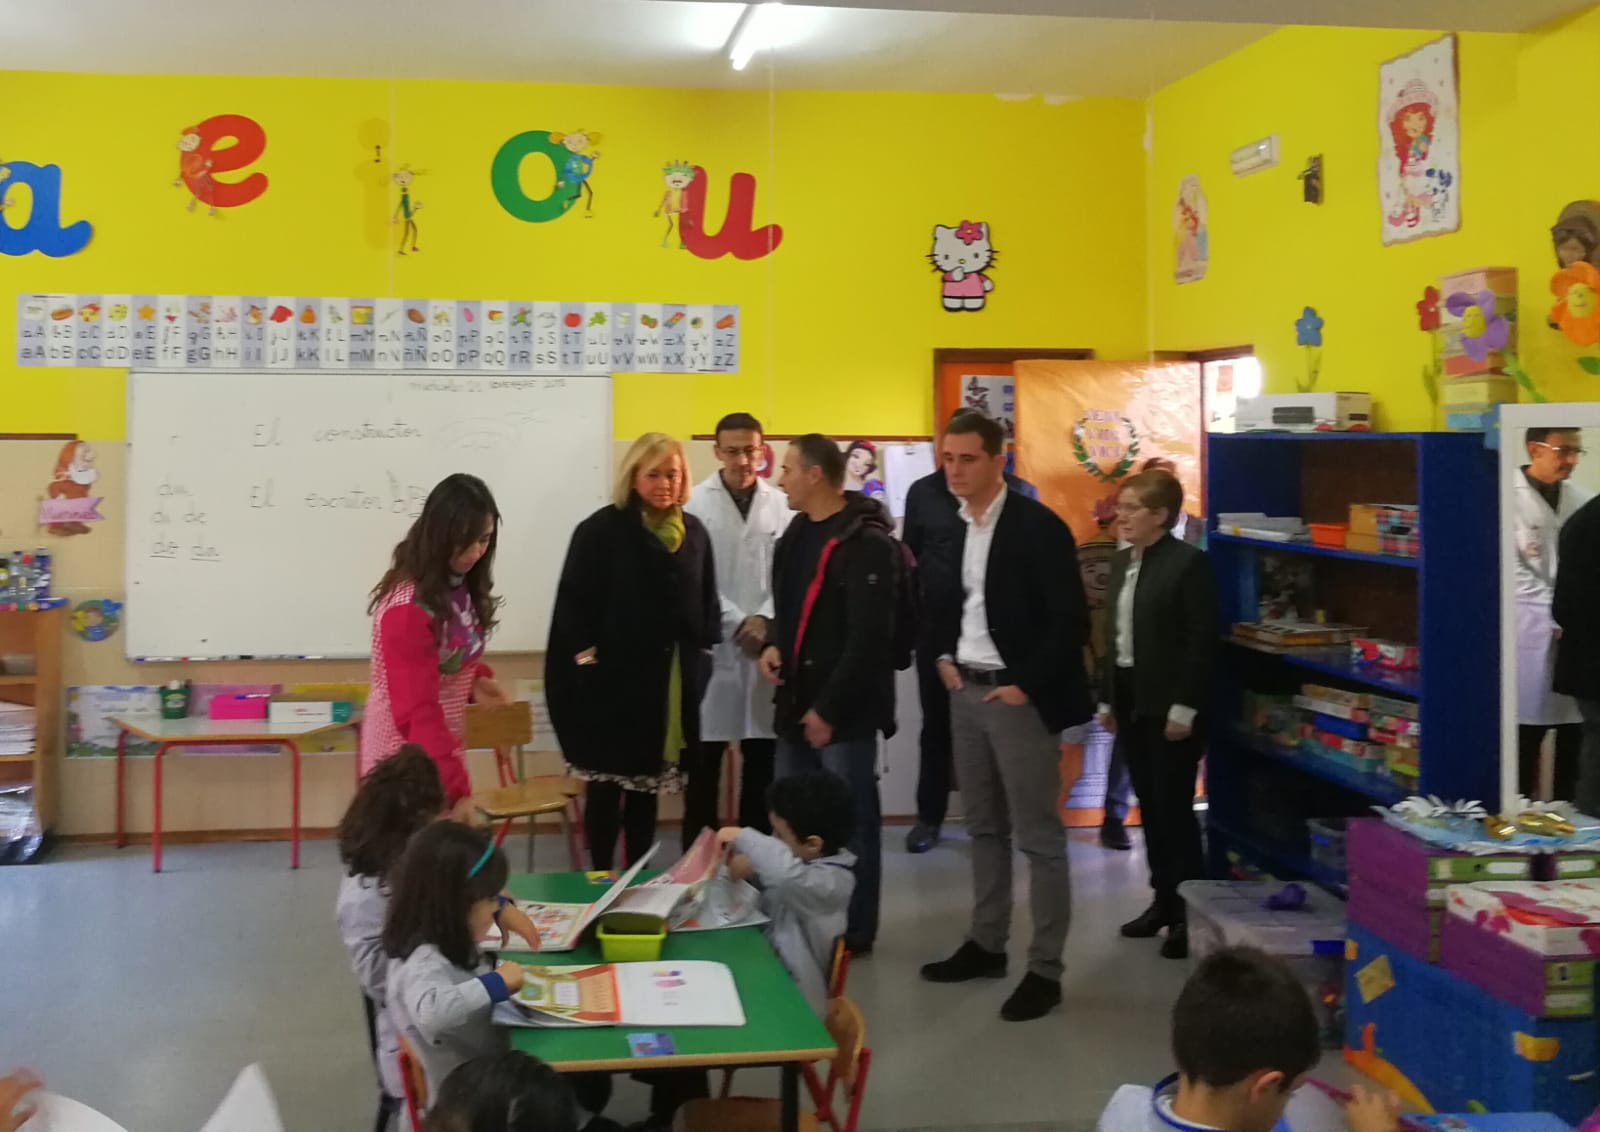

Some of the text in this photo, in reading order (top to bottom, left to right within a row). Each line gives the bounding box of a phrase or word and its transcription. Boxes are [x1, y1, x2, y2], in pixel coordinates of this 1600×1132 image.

[180, 114, 269, 208] e
[491, 130, 582, 223] o
[678, 165, 783, 261] u
